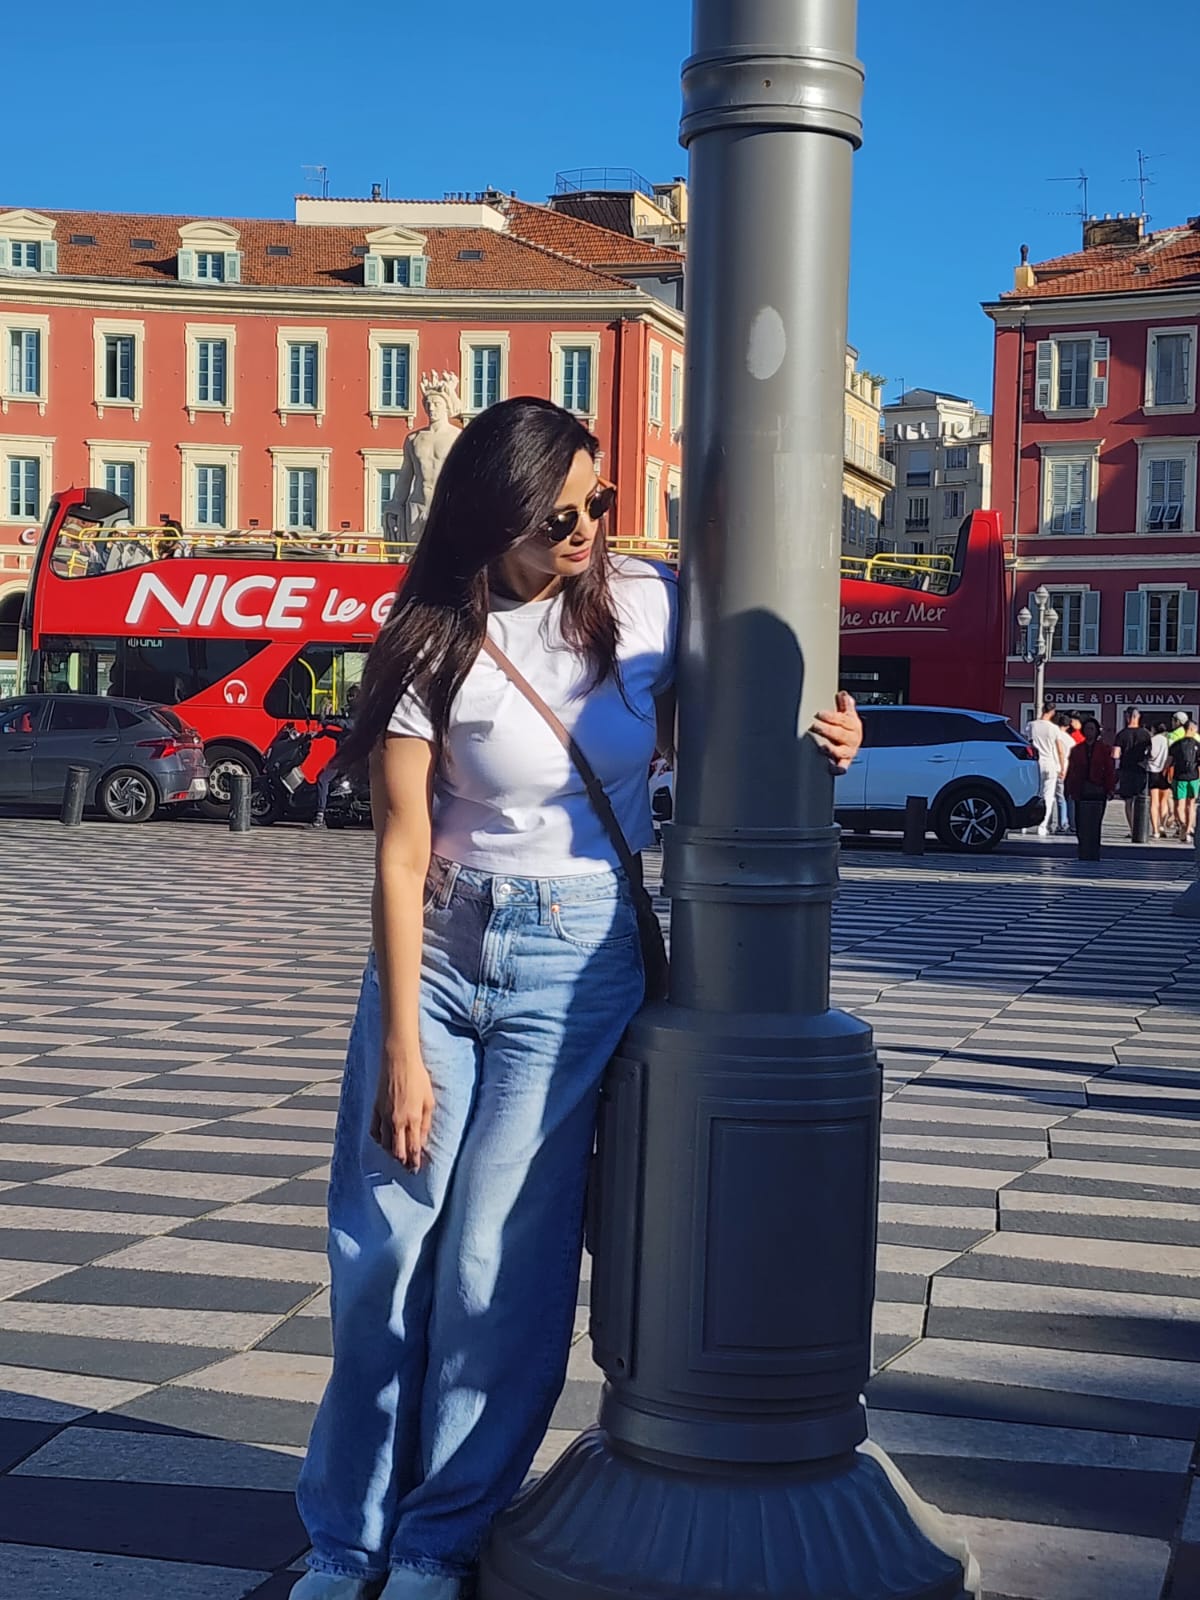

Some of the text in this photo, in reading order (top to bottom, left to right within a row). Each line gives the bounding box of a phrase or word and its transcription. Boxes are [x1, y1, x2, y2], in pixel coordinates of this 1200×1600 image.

[125, 572, 316, 628] NICE
[371, 592, 397, 626] G
[869, 610, 900, 625] sur
[904, 602, 946, 623] Mer
[1044, 693, 1185, 704] ORNE & DELAUNAY
